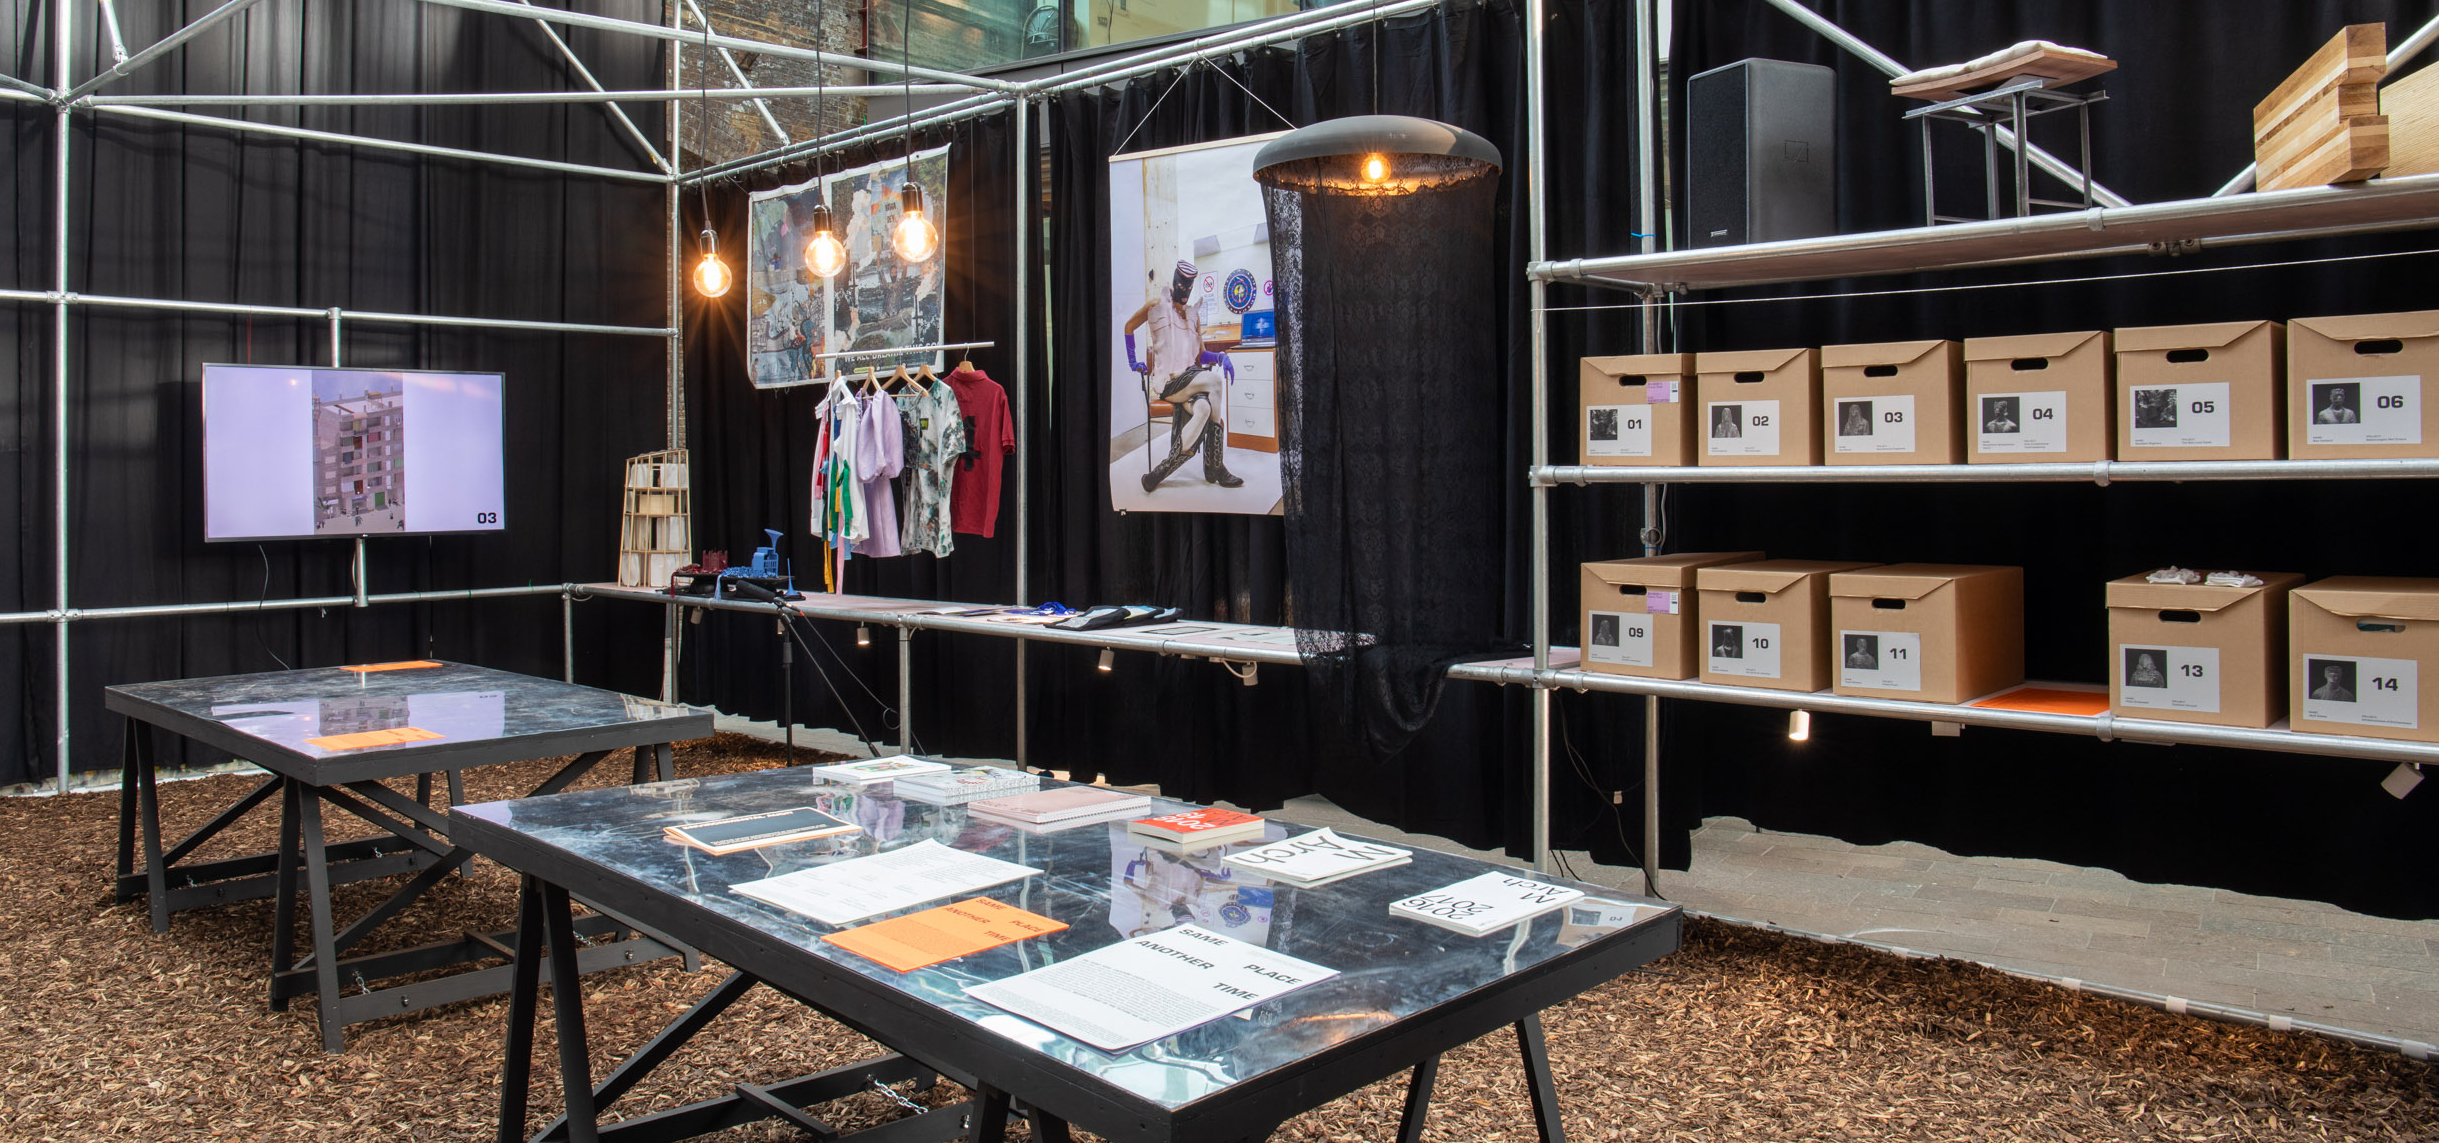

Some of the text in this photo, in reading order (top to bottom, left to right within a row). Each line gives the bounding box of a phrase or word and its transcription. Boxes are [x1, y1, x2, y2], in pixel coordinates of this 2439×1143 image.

[2191, 401, 2215, 414] 05
[2377, 395, 2404, 409] 06
[1752, 415, 1769, 426] 02
[1884, 412, 1903, 423] 03
[2032, 408, 2054, 420] 04
[1627, 419, 1642, 430] 01
[477, 512, 497, 524] 03
[1628, 627, 1644, 638] 09
[1752, 638, 1769, 649] 10
[1889, 648, 1907, 660] 11
[2180, 664, 2204, 678] 13
[2371, 677, 2399, 692] 14
[1234, 835, 1346, 864] Arch
[1334, 845, 1397, 861] M
[1502, 877, 1572, 895] Arch
[975, 898, 1007, 911] SAME
[1419, 893, 1495, 914] 2017
[1520, 892, 1556, 905] M
[943, 906, 991, 924] ANOTHER
[1401, 898, 1475, 921] 2016
[1009, 919, 1045, 934] PLACE
[983, 930, 1012, 942] TIME
[1178, 927, 1230, 947] SAME
[1134, 939, 1216, 971] ANOTHER
[1242, 963, 1303, 986] PLACE
[1212, 981, 1259, 1001] TIME
